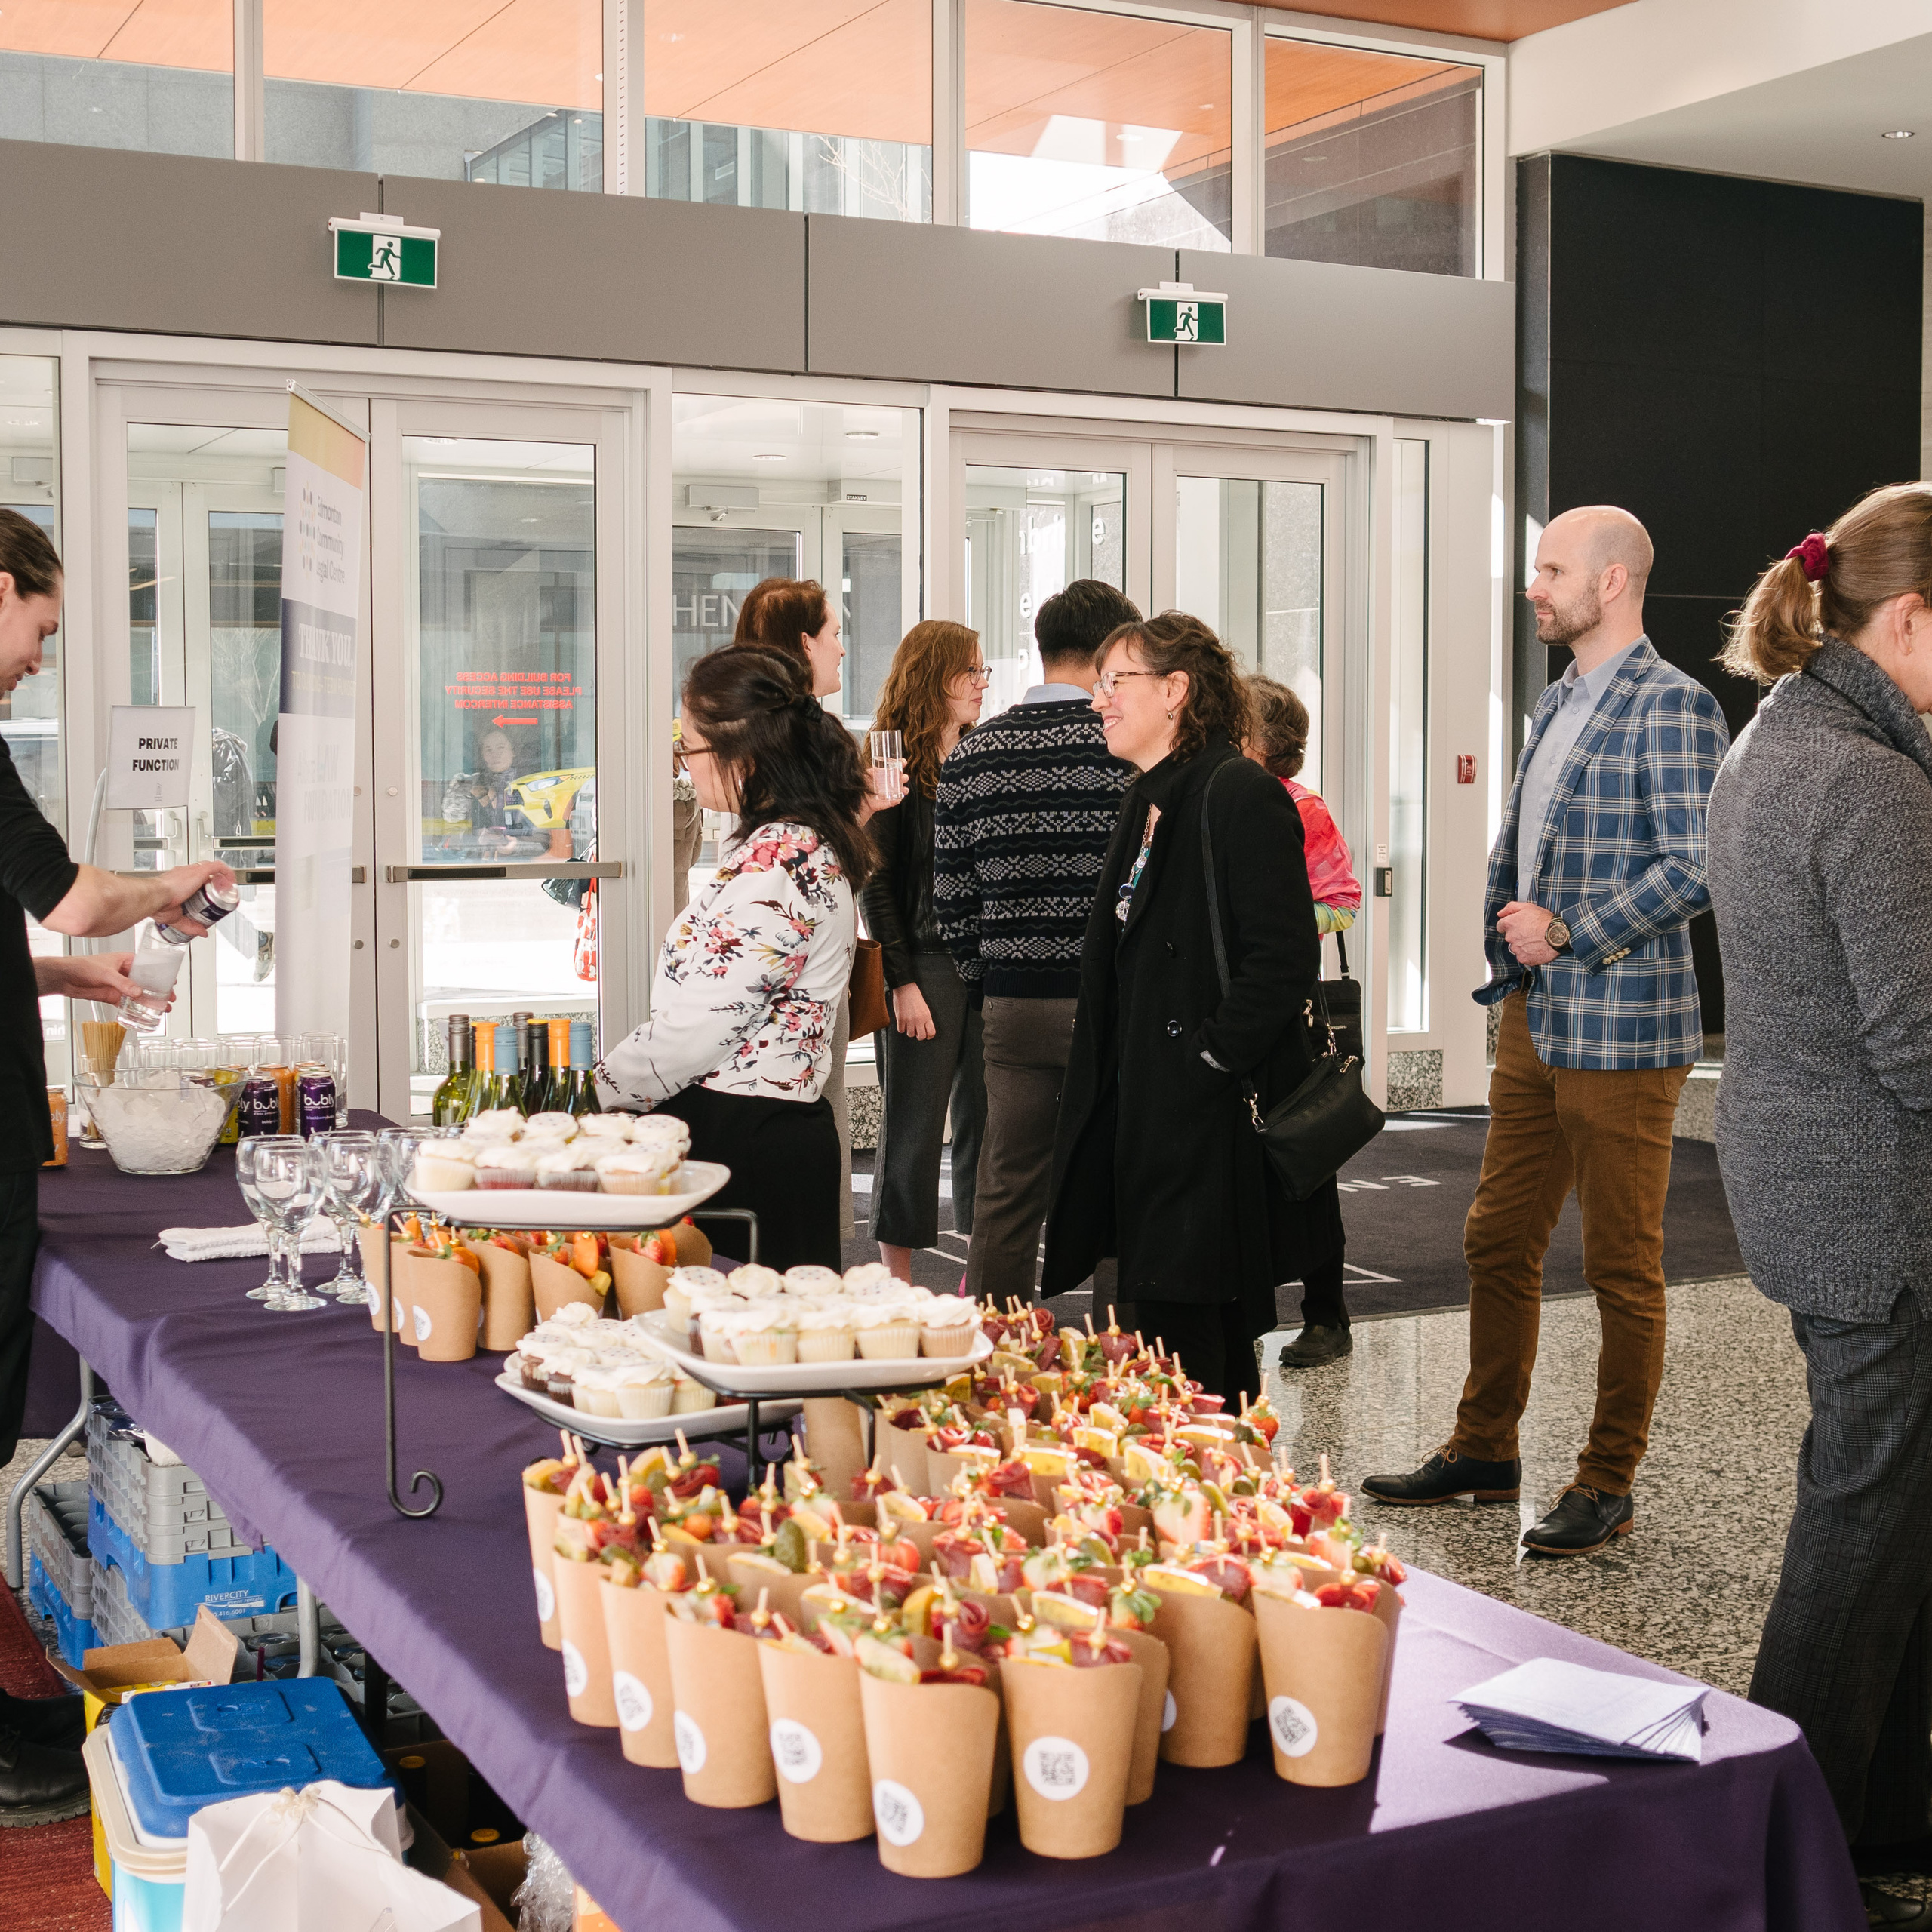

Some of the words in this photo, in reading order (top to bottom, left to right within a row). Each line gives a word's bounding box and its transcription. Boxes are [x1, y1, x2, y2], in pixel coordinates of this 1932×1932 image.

[299, 623, 331, 663] THANK
[138, 737, 178, 749] PRIVATE
[132, 759, 180, 771] FUNCTION
[304, 1094, 335, 1107] bubly
[205, 1589, 250, 1602] RIVERCITY
